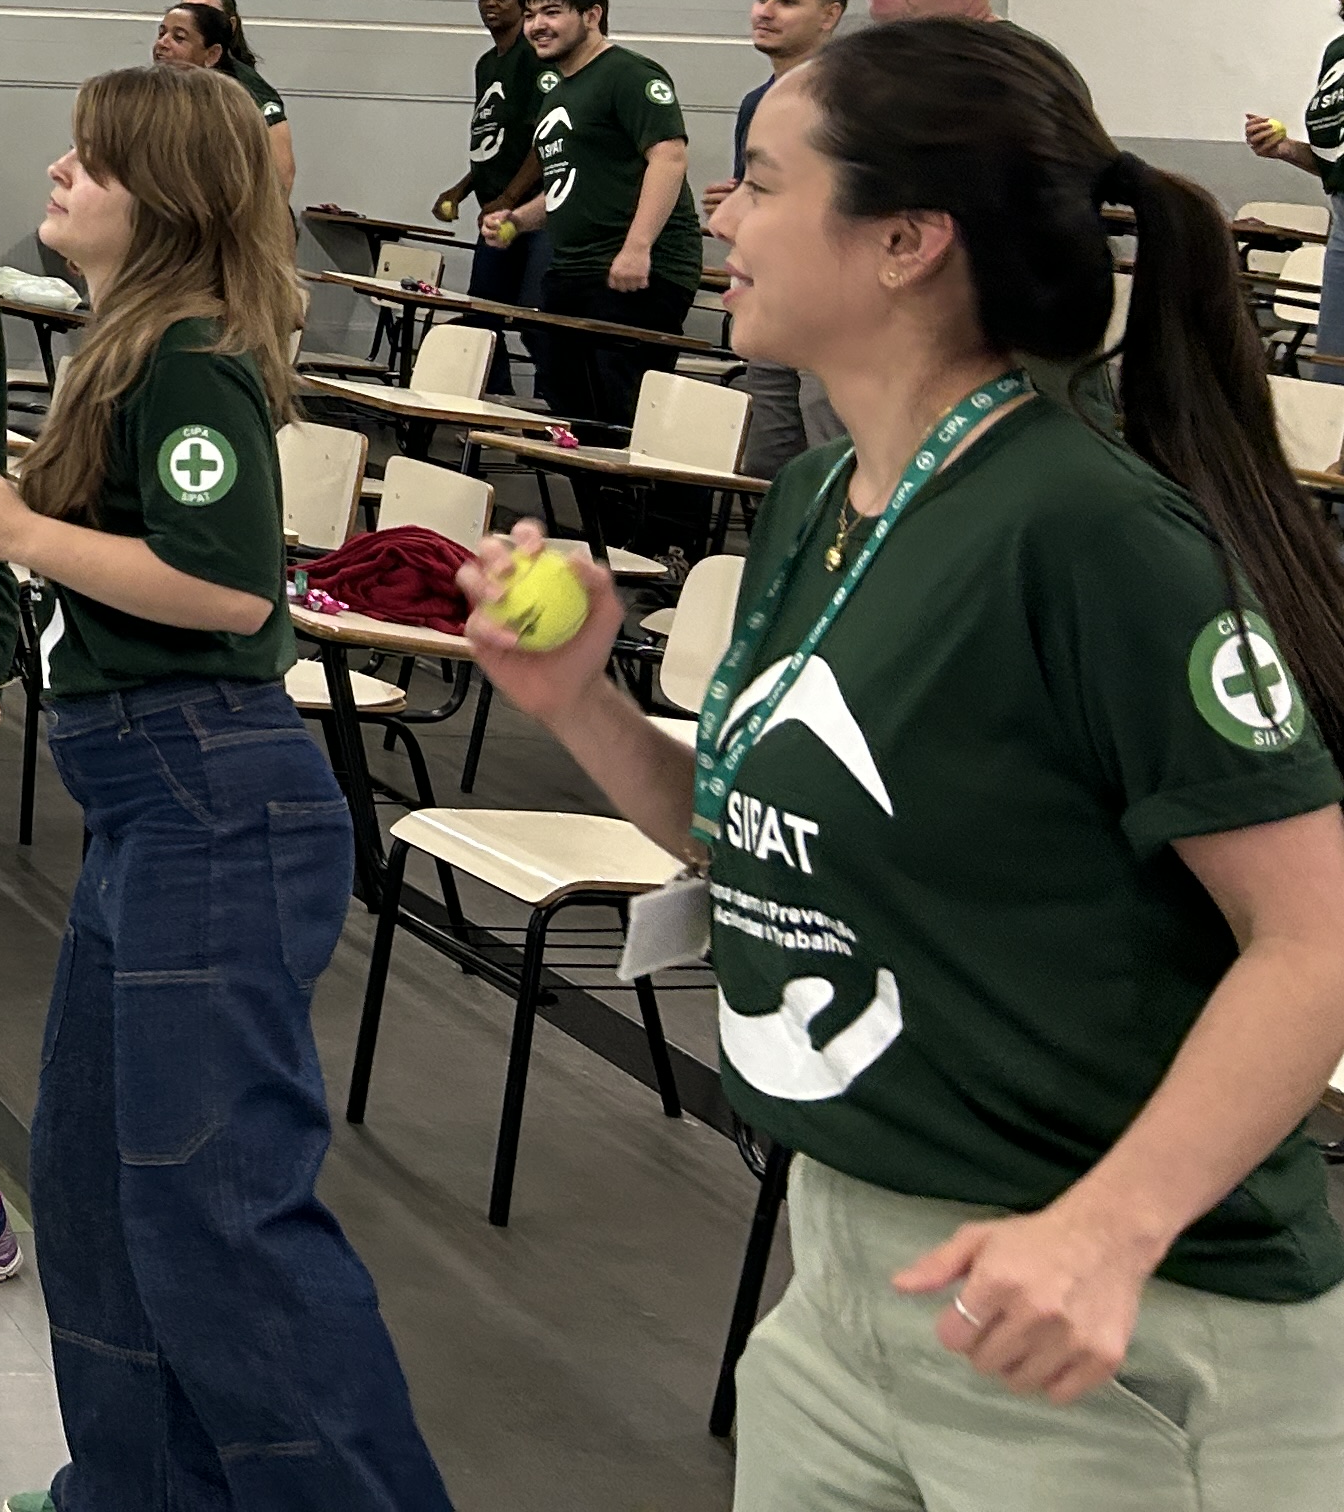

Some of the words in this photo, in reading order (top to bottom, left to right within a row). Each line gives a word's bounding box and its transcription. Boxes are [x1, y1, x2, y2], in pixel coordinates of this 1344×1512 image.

[938, 415, 968, 443] CIPA
[892, 481, 914, 510] CIPA
[727, 790, 820, 875] SIPAT
